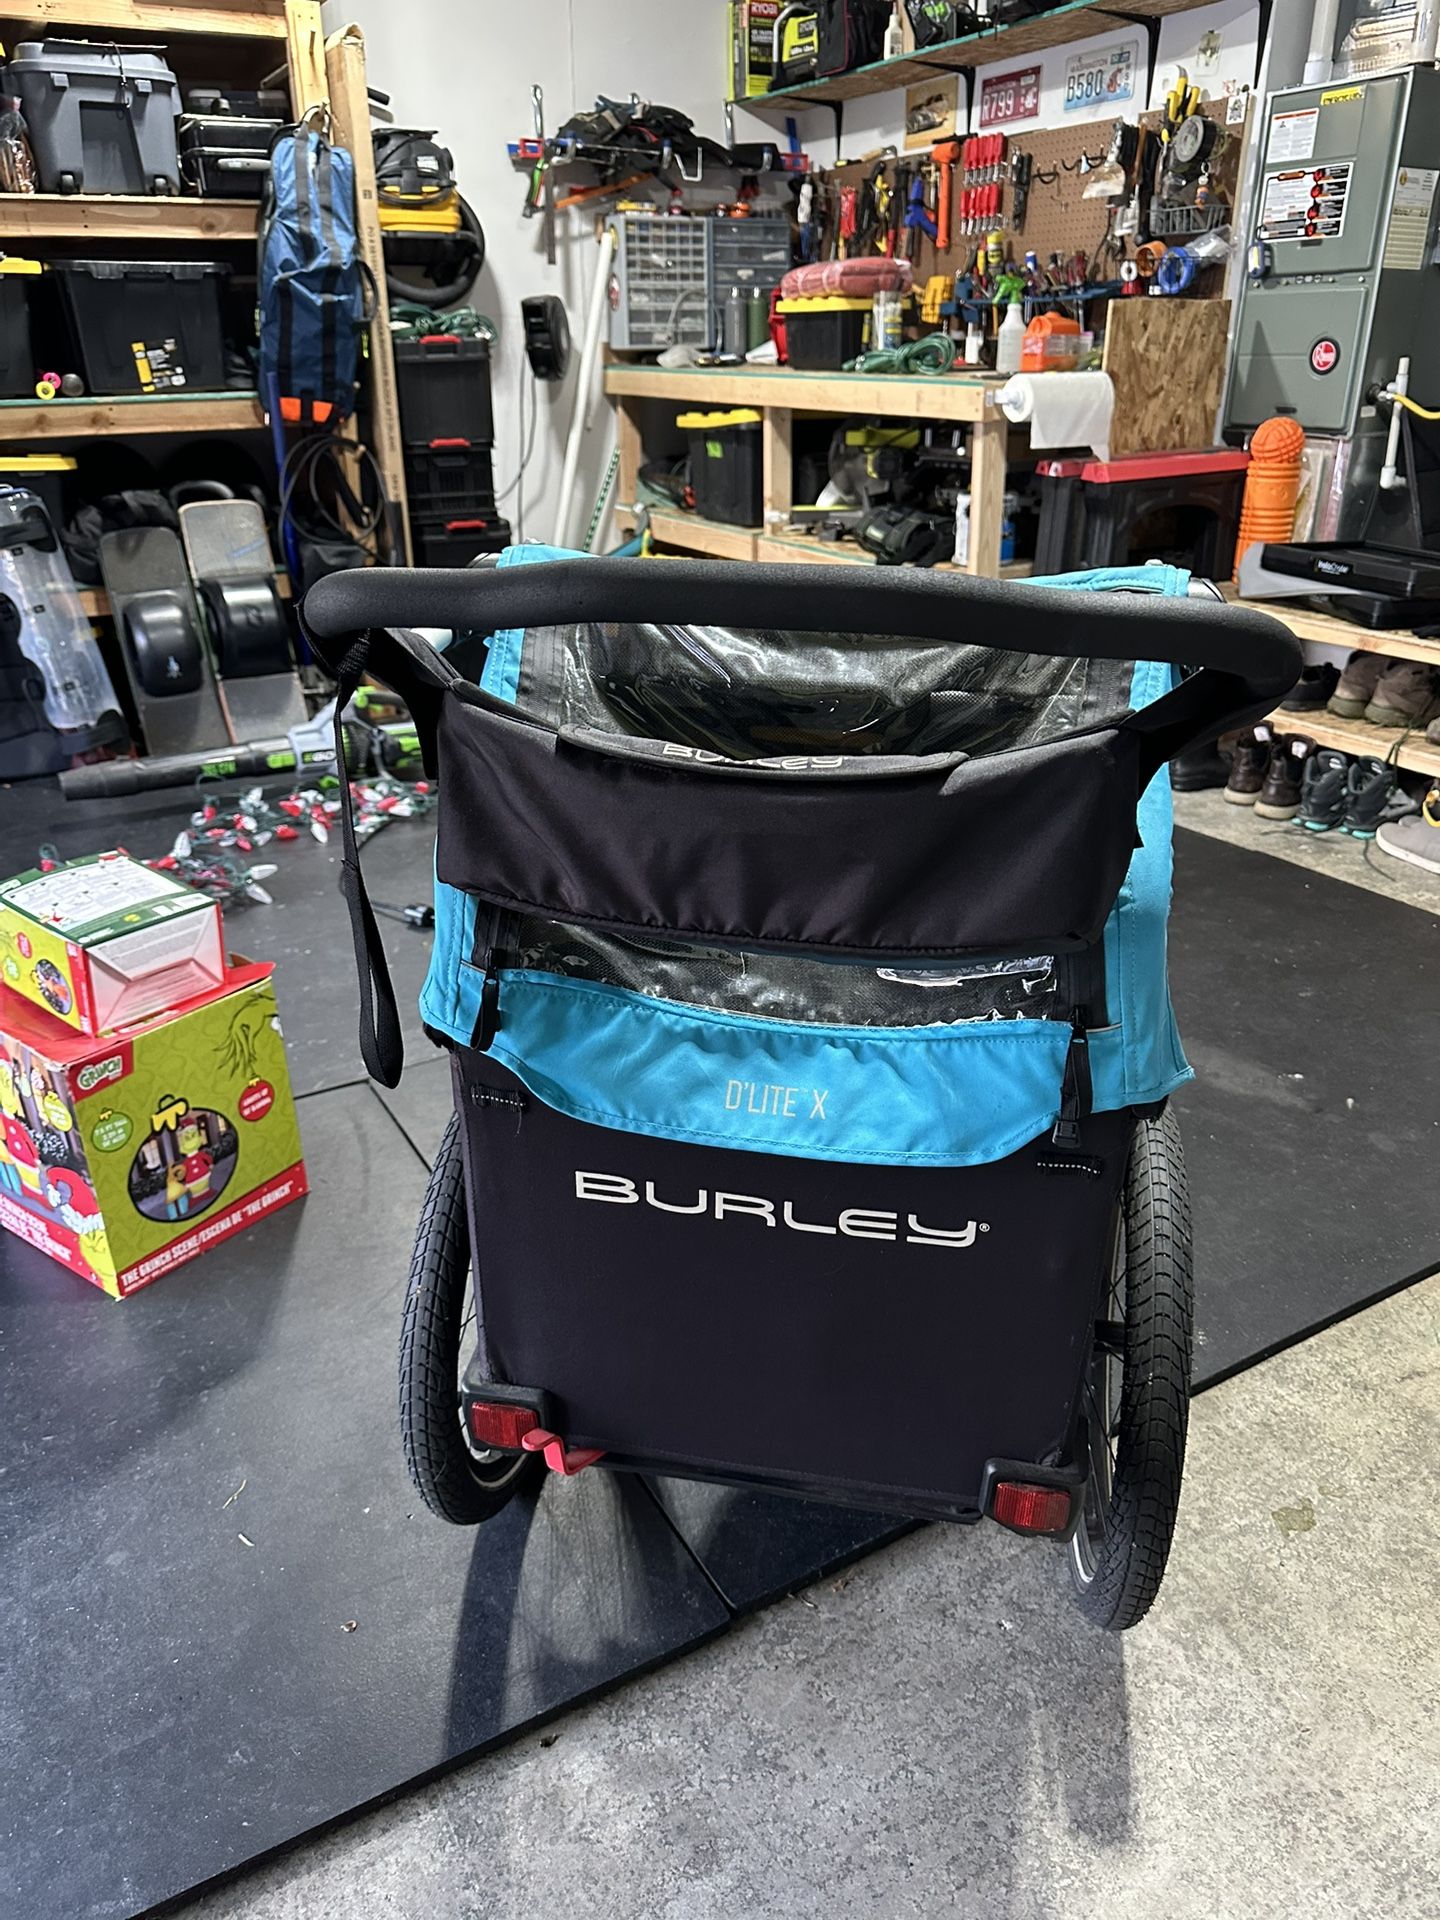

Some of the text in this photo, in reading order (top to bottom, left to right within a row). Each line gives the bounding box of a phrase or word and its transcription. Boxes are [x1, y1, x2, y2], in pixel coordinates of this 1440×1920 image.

[751, 2, 778, 14] RYOBI
[1066, 69, 1104, 102] B580
[982, 89, 1014, 121] R799
[662, 742, 843, 770] BULEY
[809, 1089, 829, 1121] X
[120, 1267, 140, 1287] THE
[139, 1250, 173, 1277] GRINCH
